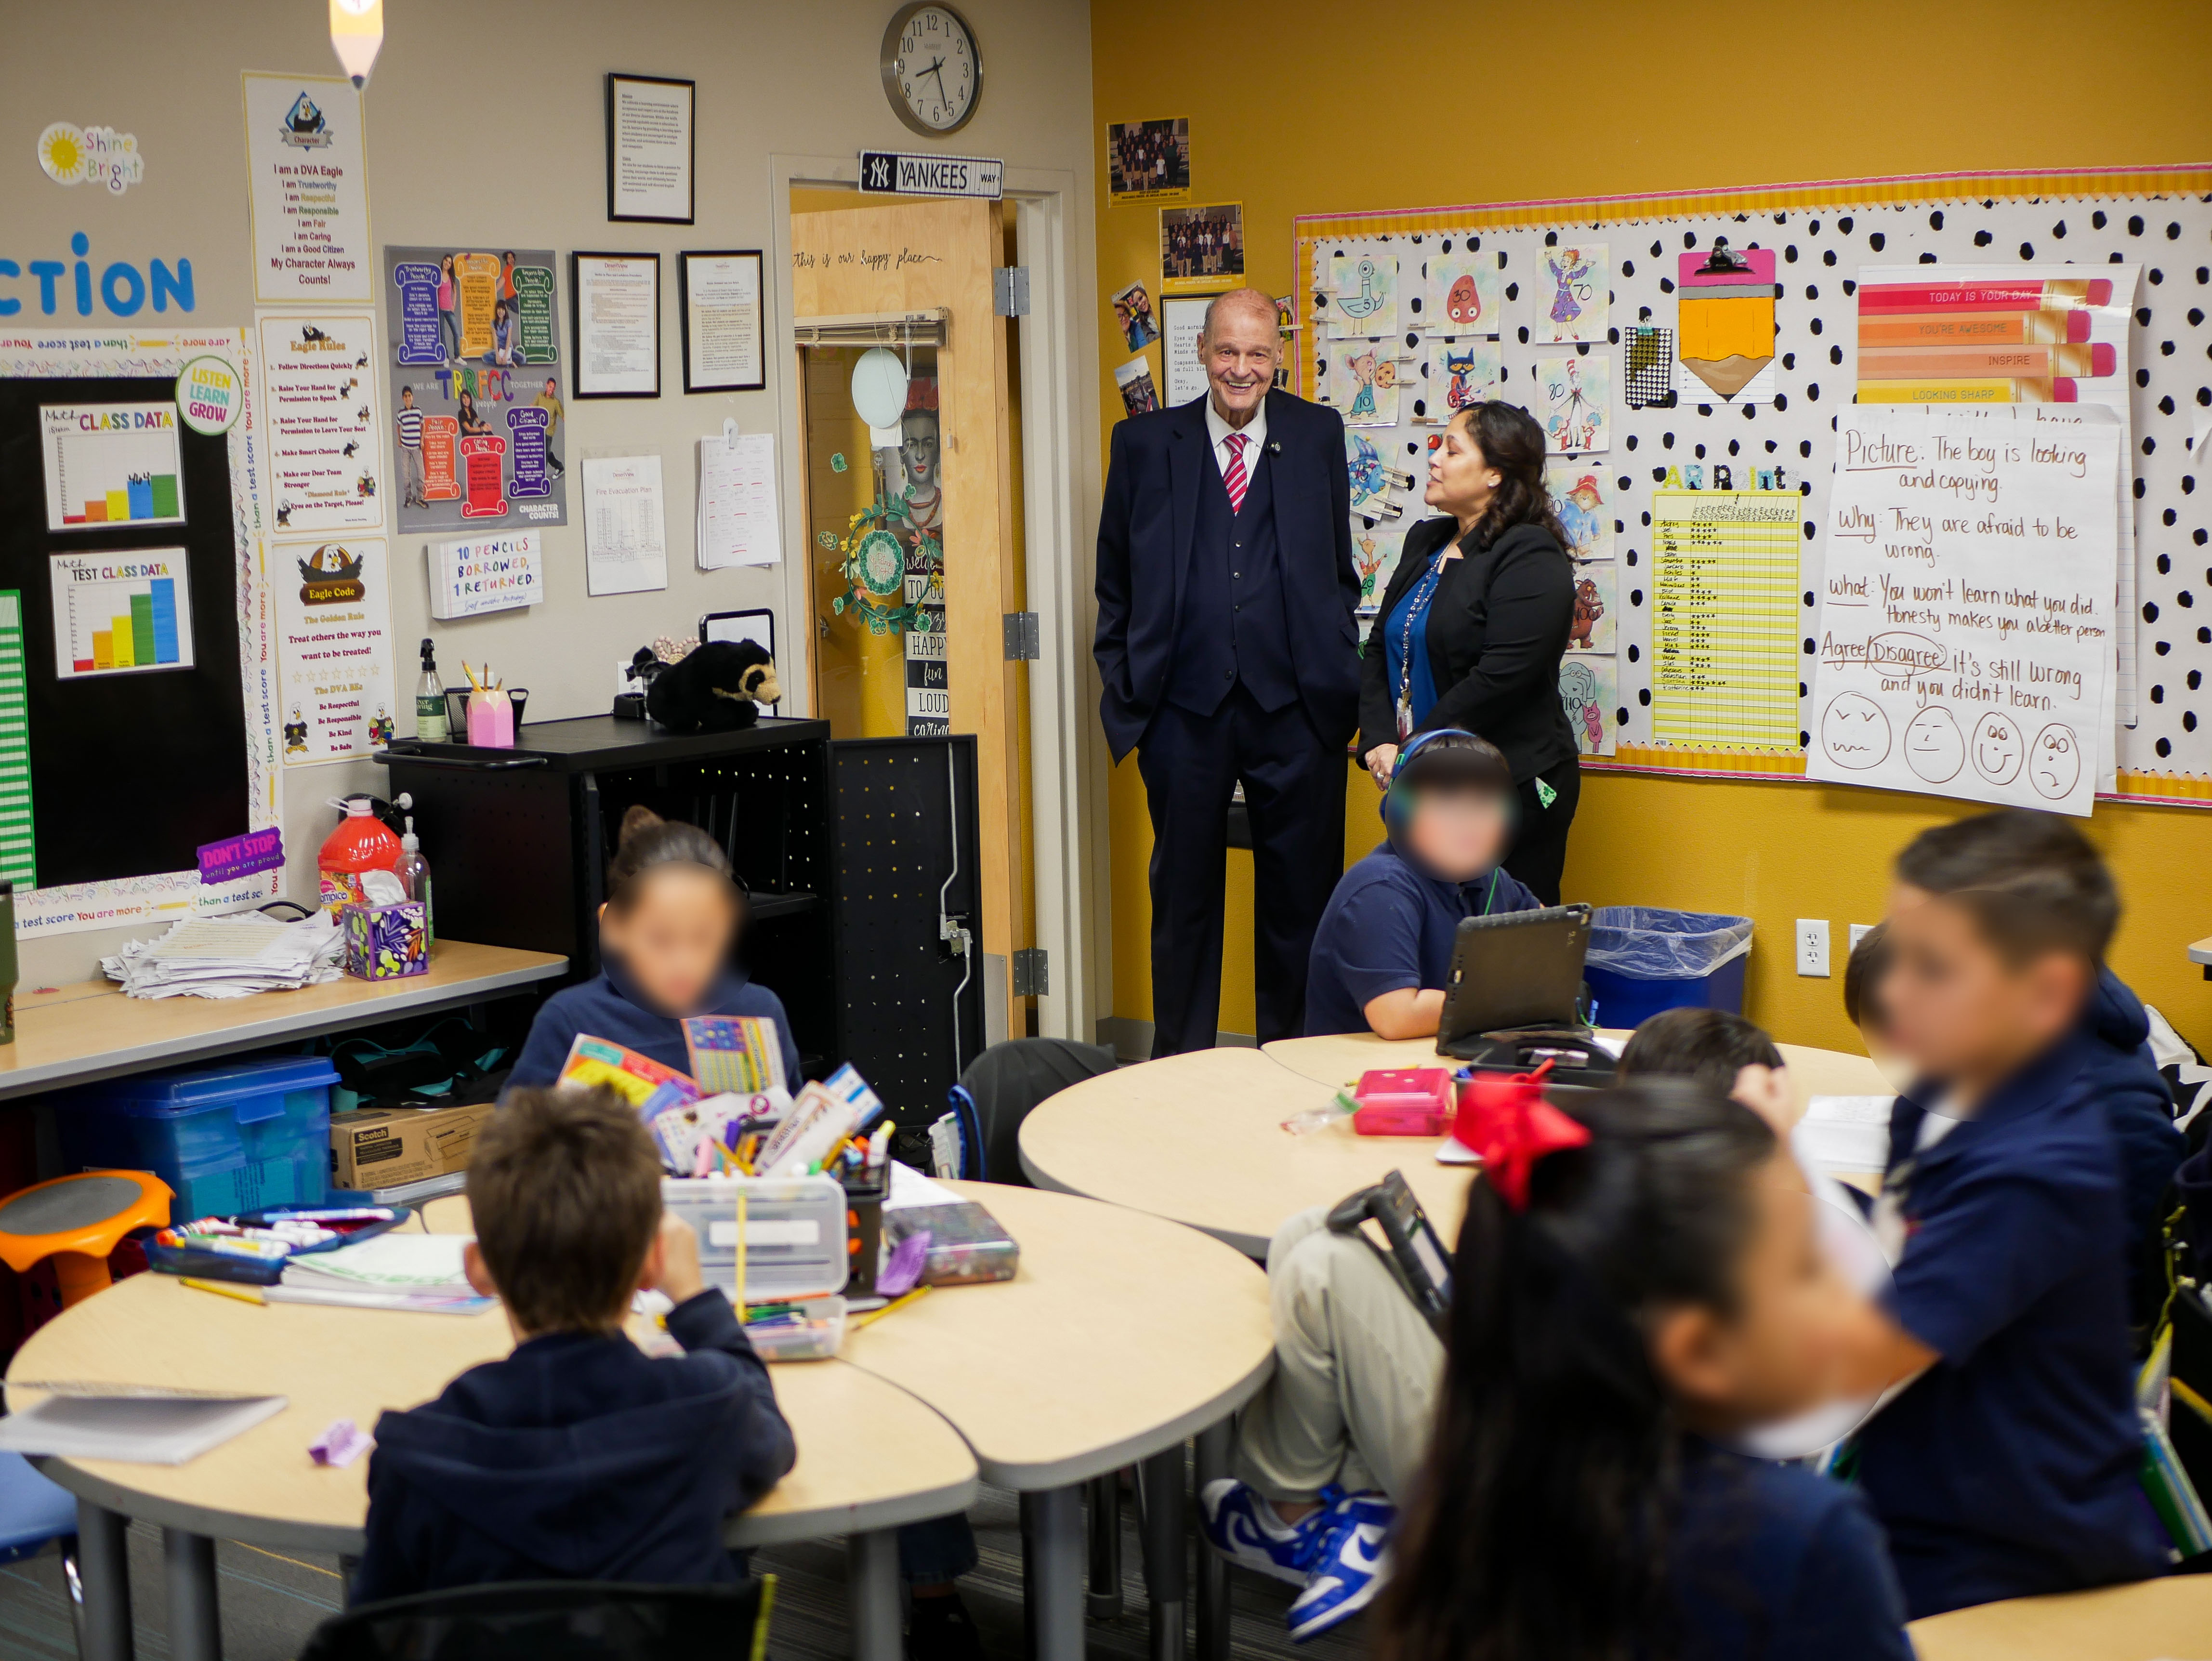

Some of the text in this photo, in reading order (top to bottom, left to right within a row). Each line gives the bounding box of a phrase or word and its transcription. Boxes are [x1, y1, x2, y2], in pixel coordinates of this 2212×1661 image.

[911, 20, 922, 37] 11
[926, 14, 938, 30] 12
[945, 21, 950, 37] 1
[902, 37, 913, 53] 10
[957, 39, 962, 54] 2
[898, 58, 905, 75] 9
[963, 63, 969, 78] 3
[905, 83, 911, 98] 8
[958, 85, 964, 100] 4
[917, 100, 923, 115] 7
[933, 106, 939, 122] 6
[948, 101, 954, 117] 5
[86, 132, 133, 153] Shine
[294, 136, 320, 144] Character
[88, 158, 139, 191] Bright
[274, 164, 277, 174] I
[279, 167, 291, 175] am
[301, 165, 318, 175] DVA
[321, 166, 343, 178] Eagle
[899, 161, 968, 189] YANKEES
[981, 173, 997, 184] WAY
[271, 258, 356, 271] My Character Always
[792, 247, 941, 271] this is our happy place
[1452, 289, 1471, 302] 30
[1573, 283, 1593, 301] 70
[1929, 290, 2033, 302] TODAY IS YOUR DAY
[1363, 299, 1371, 310] 5
[1919, 323, 2007, 334] YOU'RE AWESOME
[290, 340, 317, 353] Eagle
[330, 362, 353, 371] Quickly
[1988, 355, 2031, 366] INSPIRE
[191, 367, 232, 390] LISTEN
[413, 382, 425, 390] WE
[426, 382, 439, 390] ARE
[435, 368, 514, 402] TRRFCC
[190, 384, 230, 406] LEARN
[1548, 383, 1565, 401] 80
[1913, 389, 1995, 400] LOOKING SHARP
[1359, 396, 1371, 409] 10
[189, 401, 227, 423] GROW
[79, 412, 130, 431] CLASS
[134, 411, 174, 429] DATA
[246, 435, 254, 465] score
[1932, 435, 1961, 461] The
[1968, 436, 1995, 473] boy
[2005, 441, 2021, 463] is
[2030, 437, 2087, 478] looking
[1662, 464, 1704, 490] AR
[1899, 469, 2003, 503] and copying.
[519, 504, 558, 514] CHARACTER
[529, 511, 559, 520] COUNTS!
[1888, 507, 1933, 543] They
[1942, 516, 1971, 534] are
[1977, 512, 2024, 538] afraid
[2032, 517, 2050, 537] to
[2055, 517, 2079, 539] be
[457, 537, 529, 560] 10 PENCILS
[72, 563, 169, 581] TEST CLASS DATA
[458, 556, 529, 578] BORROWED,
[309, 587, 355, 600] Eagle Code
[454, 574, 535, 597] 1 RETURNED.
[908, 580, 922, 599] TO
[1879, 573, 1905, 609] You
[1913, 578, 1954, 601] won't
[1962, 578, 2000, 604] learn
[2005, 588, 2039, 609] what
[2042, 596, 2066, 622] you
[2070, 593, 2099, 616] did.
[1886, 604, 1941, 632] Honesty
[1948, 610, 1993, 630] makes
[1997, 617, 2019, 641] you
[2076, 625, 2106, 644] person
[289, 629, 382, 645] Treat others the way you
[301, 646, 372, 661] want to be treated!
[924, 662, 943, 686] fun
[1953, 648, 1979, 674] it's
[1989, 654, 2021, 684] still
[2029, 658, 2082, 700] wrong
[1881, 675, 2057, 711] and you didn't learn.
[919, 693, 948, 713] LOUD
[202, 834, 276, 869] DON'T STOP
[227, 865, 240, 876] you
[243, 860, 255, 869] are
[258, 853, 280, 867] proud
[358, 1129, 387, 1141] Scotch
